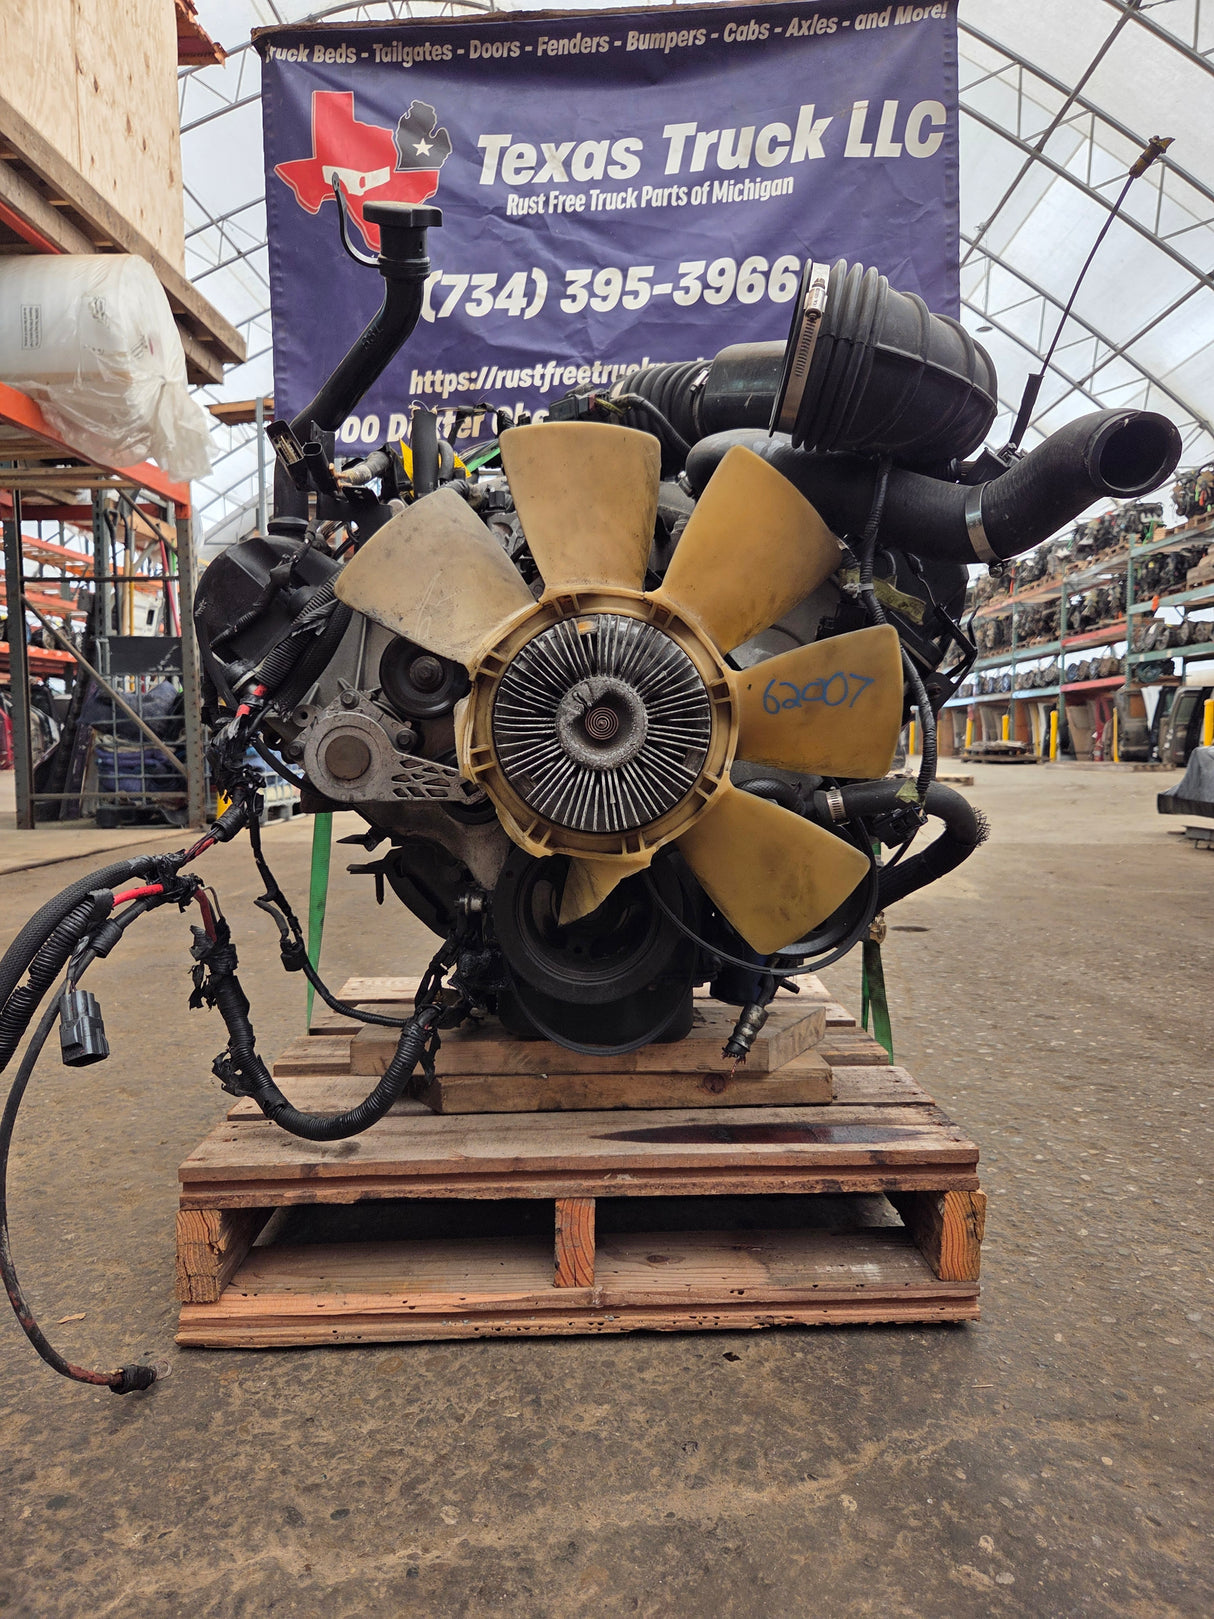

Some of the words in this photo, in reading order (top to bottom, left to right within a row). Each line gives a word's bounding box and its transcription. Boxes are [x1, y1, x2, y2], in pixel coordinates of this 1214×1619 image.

[312, 42, 357, 64] Beds
[373, 40, 453, 68] Tailgates
[469, 39, 521, 59] Doors
[537, 32, 609, 56] Fenders
[626, 27, 707, 54] Bumpers
[723, 19, 770, 43] Cabs
[785, 13, 838, 38] Axles
[854, 6, 890, 31] and
[894, 2, 948, 26] More!
[477, 133, 644, 186] Texas
[662, 104, 834, 175] Truck
[843, 99, 948, 158] LLC
[506, 192, 546, 217] Rust
[549, 190, 586, 214] Free
[589, 183, 638, 211] Truck
[640, 181, 688, 208] Parts
[690, 181, 712, 207] of
[712, 175, 795, 205] Michigan
[419, 266, 549, 323] (734)
[560, 254, 801, 314] 395-3966
[334, 412, 381, 444] 00
[387, 407, 486, 444] Dter
[763, 671, 875, 715] 62007
